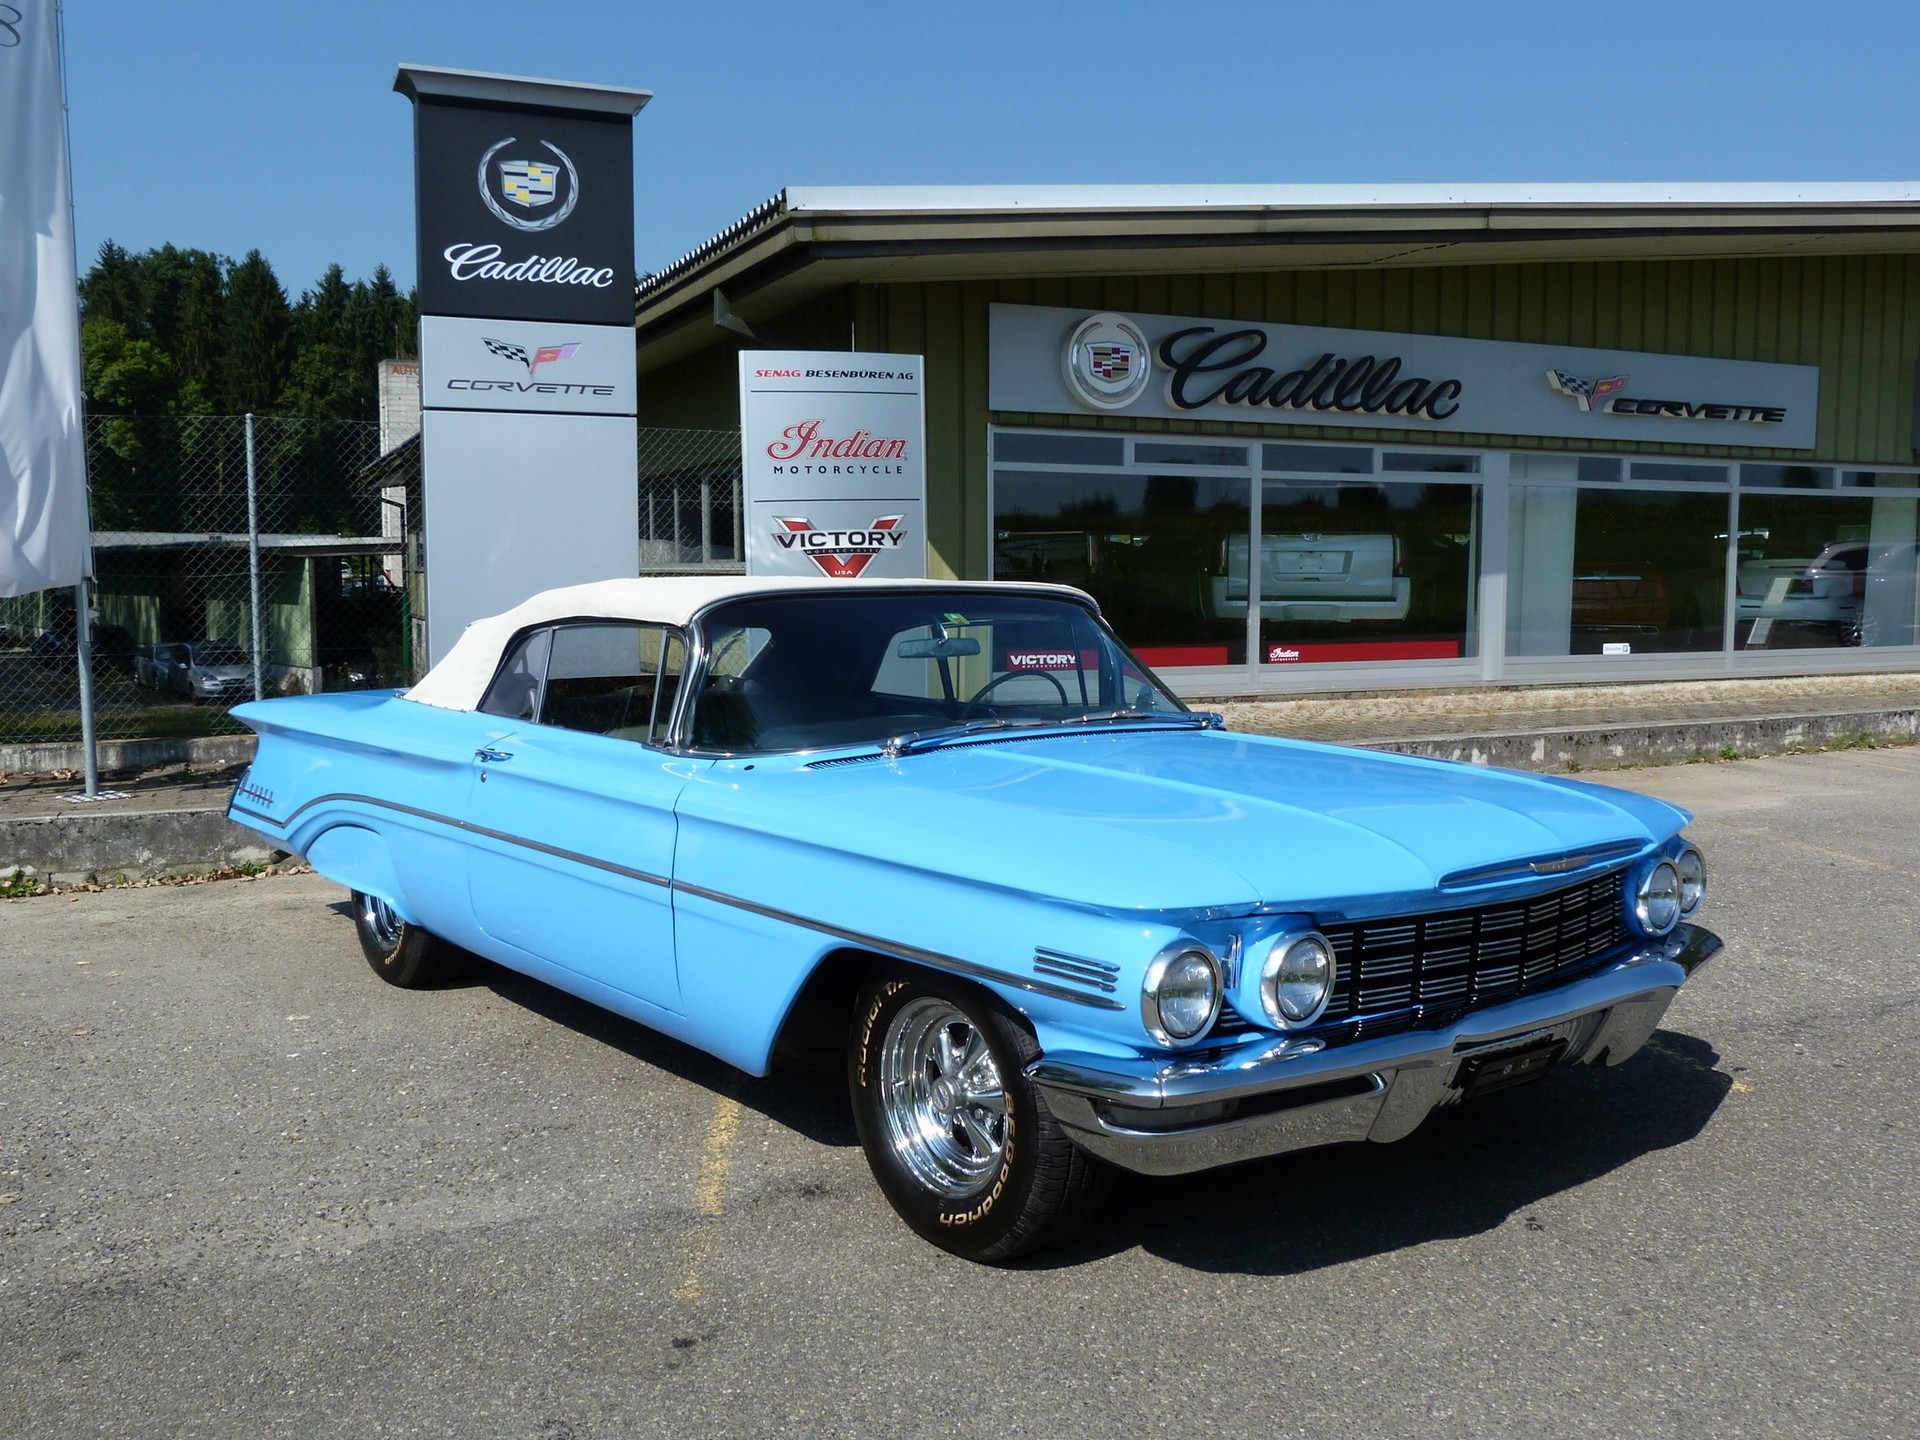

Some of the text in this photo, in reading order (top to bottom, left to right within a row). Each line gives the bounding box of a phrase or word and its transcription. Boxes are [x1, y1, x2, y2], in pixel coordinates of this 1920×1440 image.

[443, 243, 614, 288] Cadillac
[755, 369, 914, 381] SENAG BESENBÜREN AG
[1157, 326, 1462, 420] Cadillac
[447, 379, 615, 396] CORVETTE
[1611, 397, 1787, 423] CORVETTE
[765, 419, 909, 461] Indian
[773, 465, 903, 475] MOTORCYCLE
[776, 531, 906, 549] VICTORY
[1010, 654, 1077, 665] VICTORY
[1270, 647, 1300, 659] Indian
[857, 995, 884, 1088] Radial
[939, 1092, 1017, 1226] BFGoodrich
